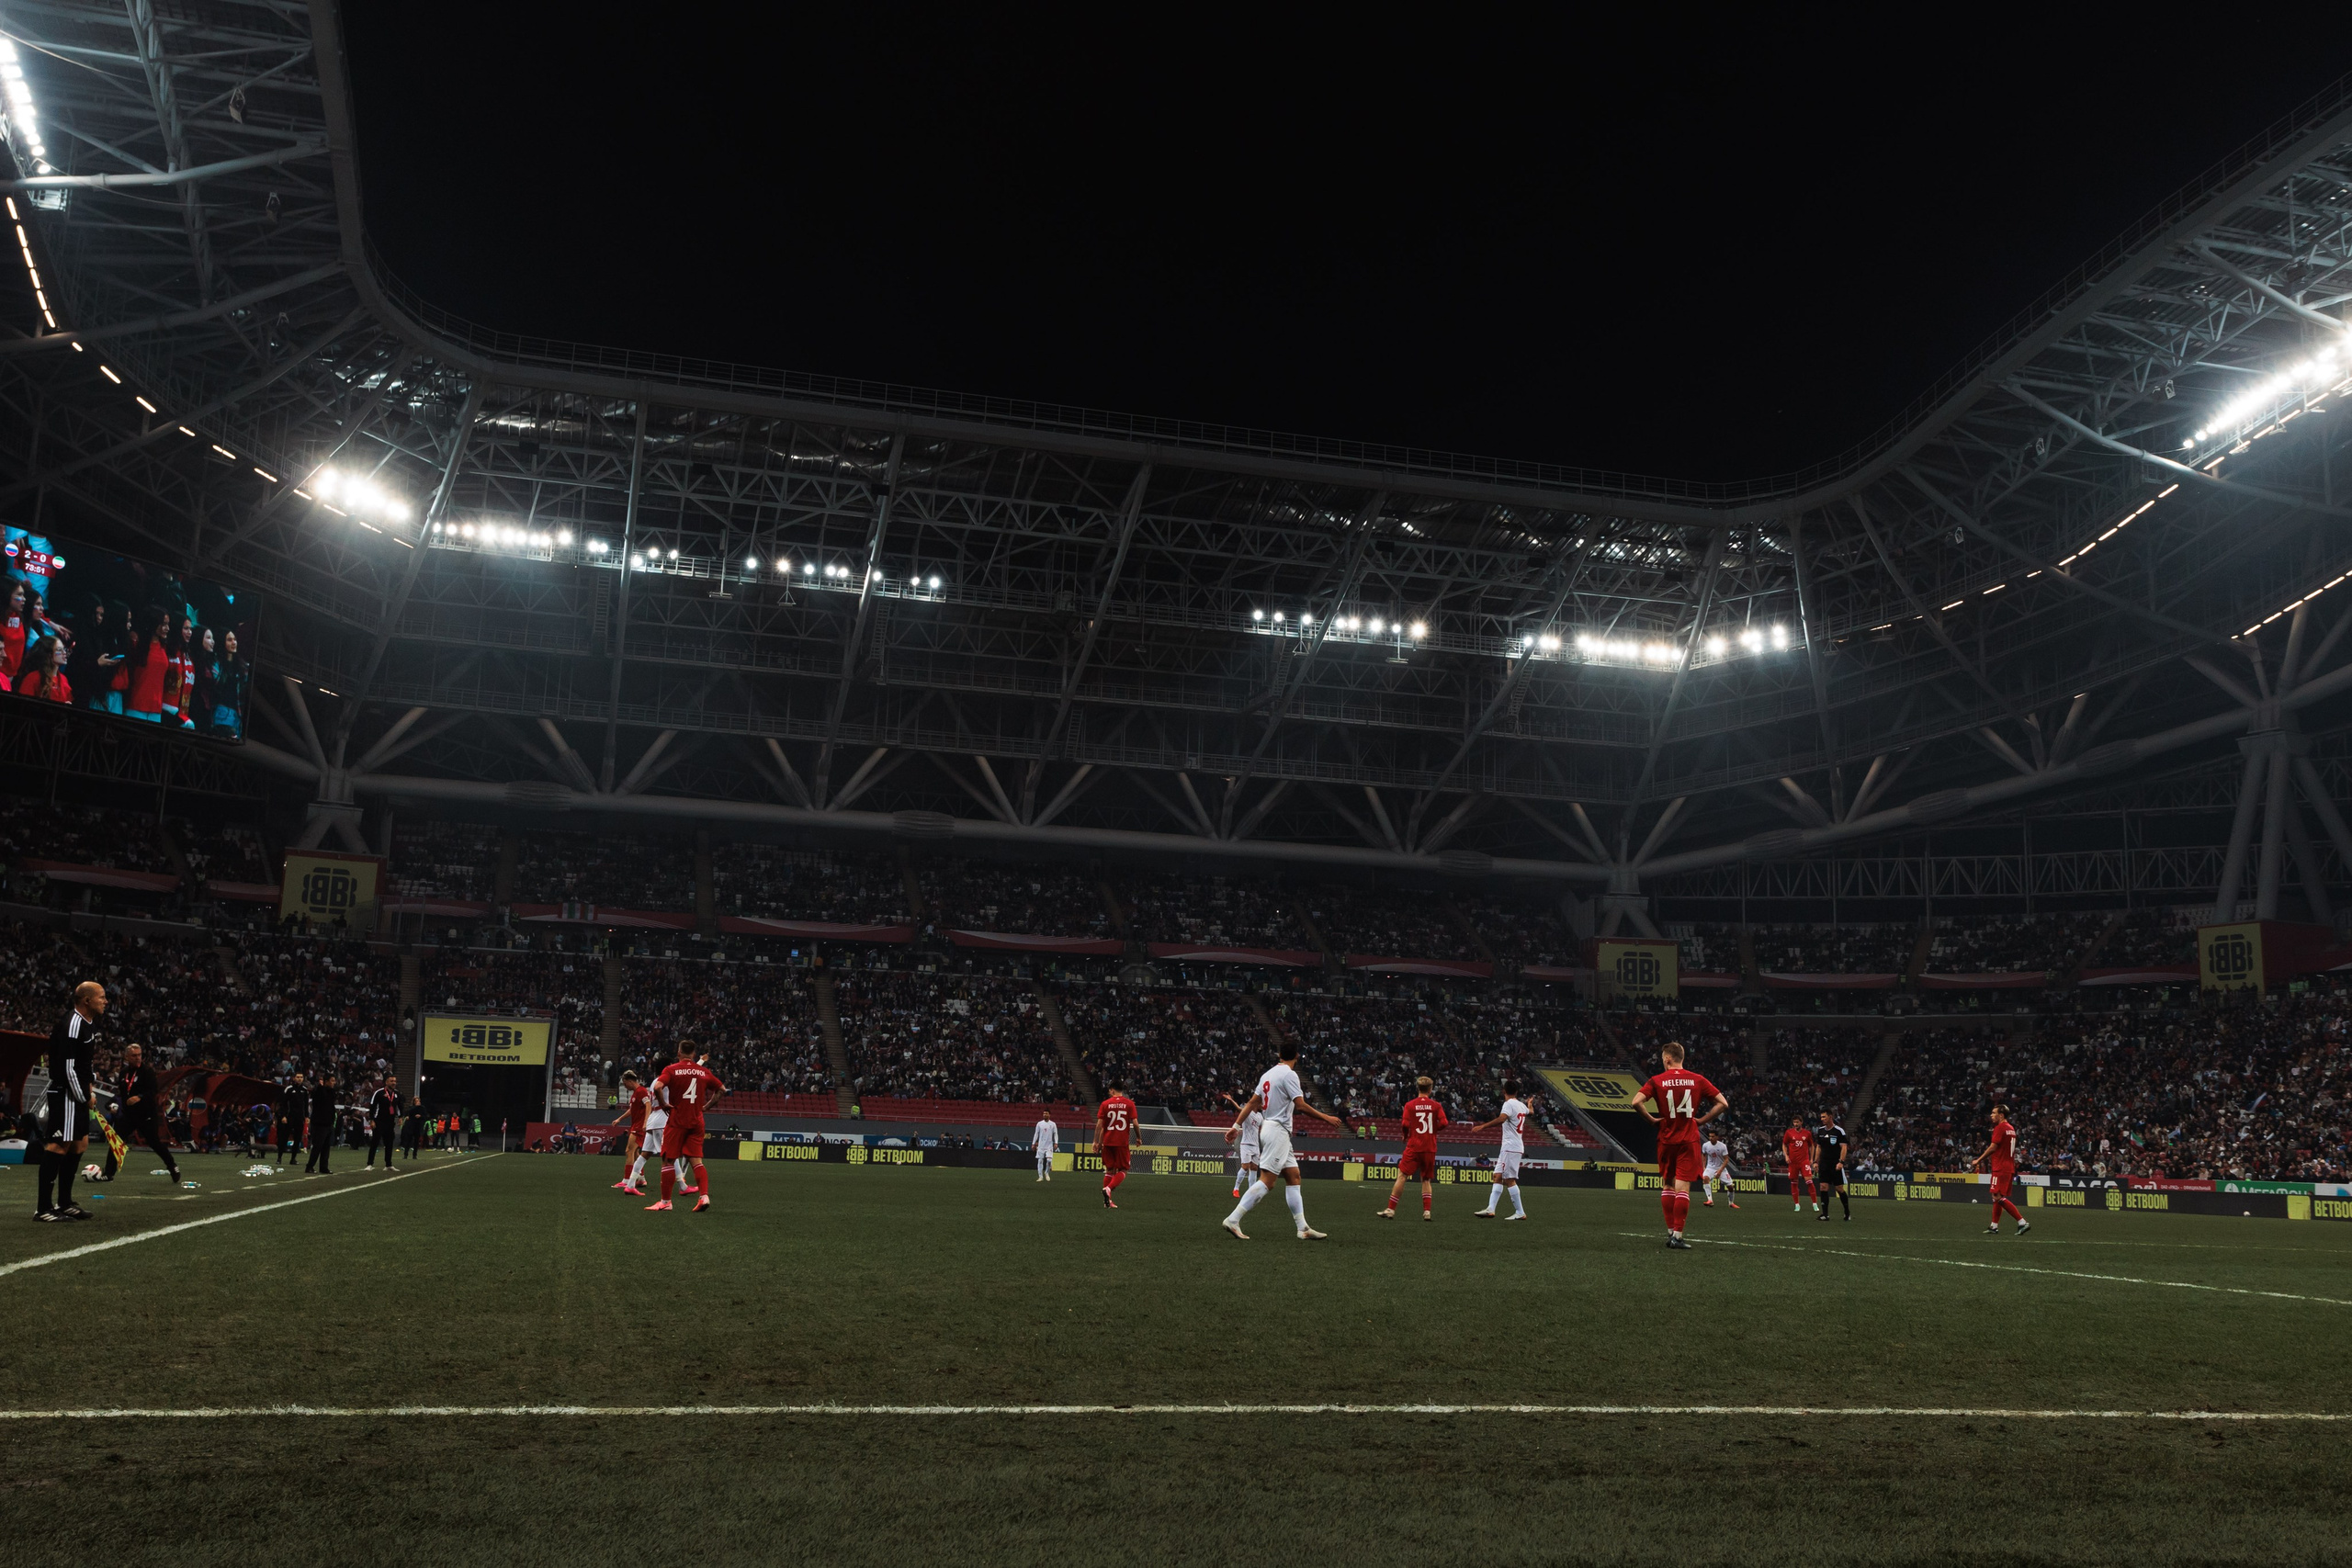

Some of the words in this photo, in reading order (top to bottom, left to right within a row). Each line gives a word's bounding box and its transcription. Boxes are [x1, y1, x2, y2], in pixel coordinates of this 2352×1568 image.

[25, 550, 31, 558] 2
[40, 555, 47, 563] 0
[449, 1053, 520, 1062] BETBOOM
[682, 1077, 697, 1104] 4
[1661, 1078, 1695, 1087] MELEKHIN
[1587, 1101, 1634, 1110] BETBOO
[1666, 1089, 1694, 1119] 14
[1106, 1110, 1128, 1131] 25
[1415, 1111, 1433, 1134] 31
[766, 1145, 819, 1160] BETBOOM
[873, 1148, 923, 1164] BETBOOM
[1176, 1159, 1224, 1174] BETBOOM
[1460, 1169, 1495, 1183] BETBOO
[1724, 1179, 1765, 1192] TBOOM
[1849, 1183, 1879, 1197] BETBOOM
[1910, 1185, 1941, 1200] BETBOOM
[2046, 1190, 2086, 1206] BETBOOM
[2126, 1192, 2169, 1210] BETBOOM
